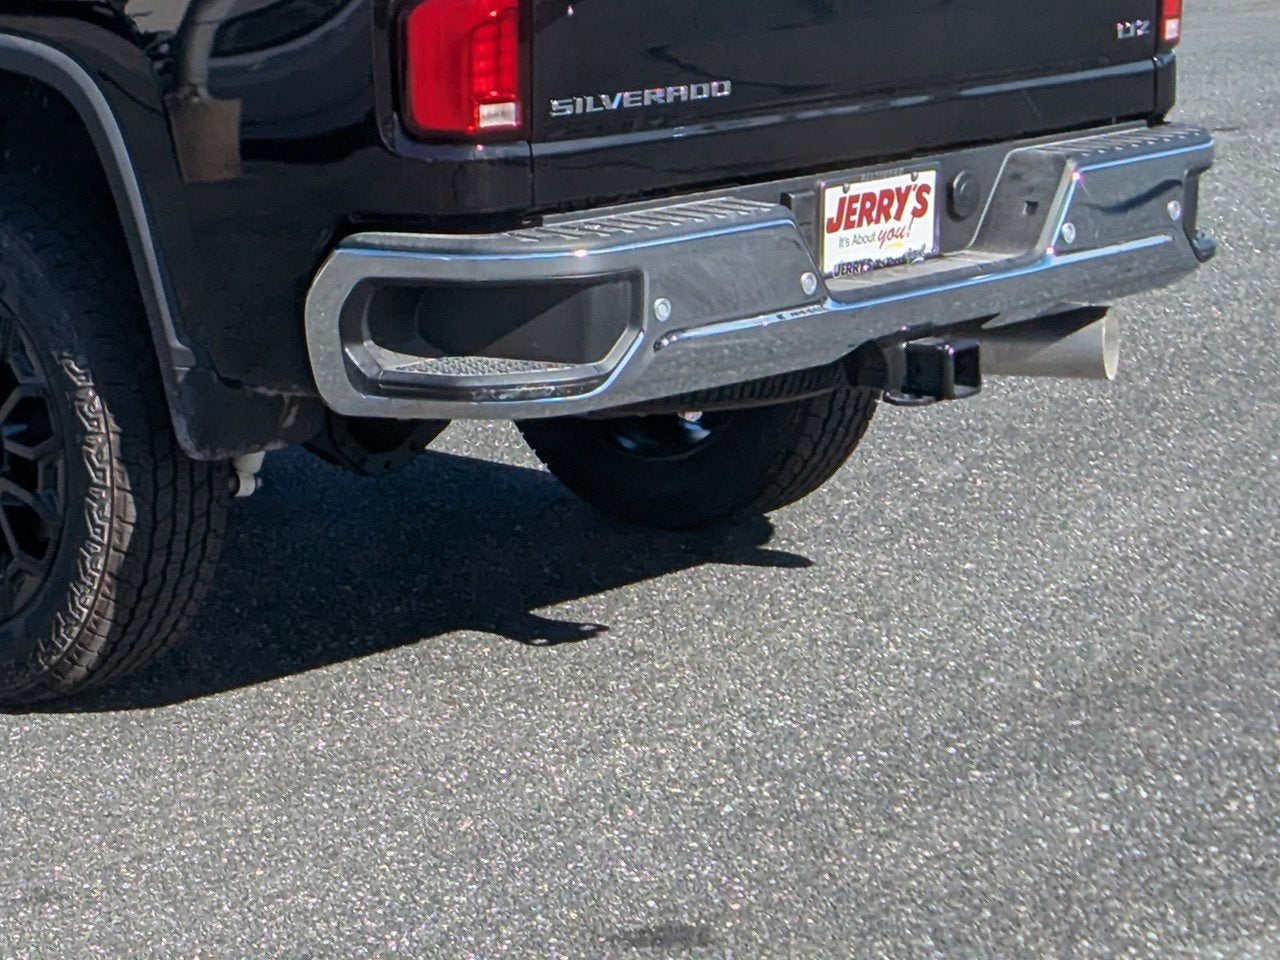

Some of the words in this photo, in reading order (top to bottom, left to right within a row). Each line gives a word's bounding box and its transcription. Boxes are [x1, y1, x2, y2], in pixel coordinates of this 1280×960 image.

[1115, 18, 1151, 39] LTZ
[549, 79, 732, 117] SILVERADO
[826, 183, 931, 234] JERRY'S
[838, 236, 850, 249] It's
[851, 231, 876, 246] About
[877, 216, 914, 249] you!
